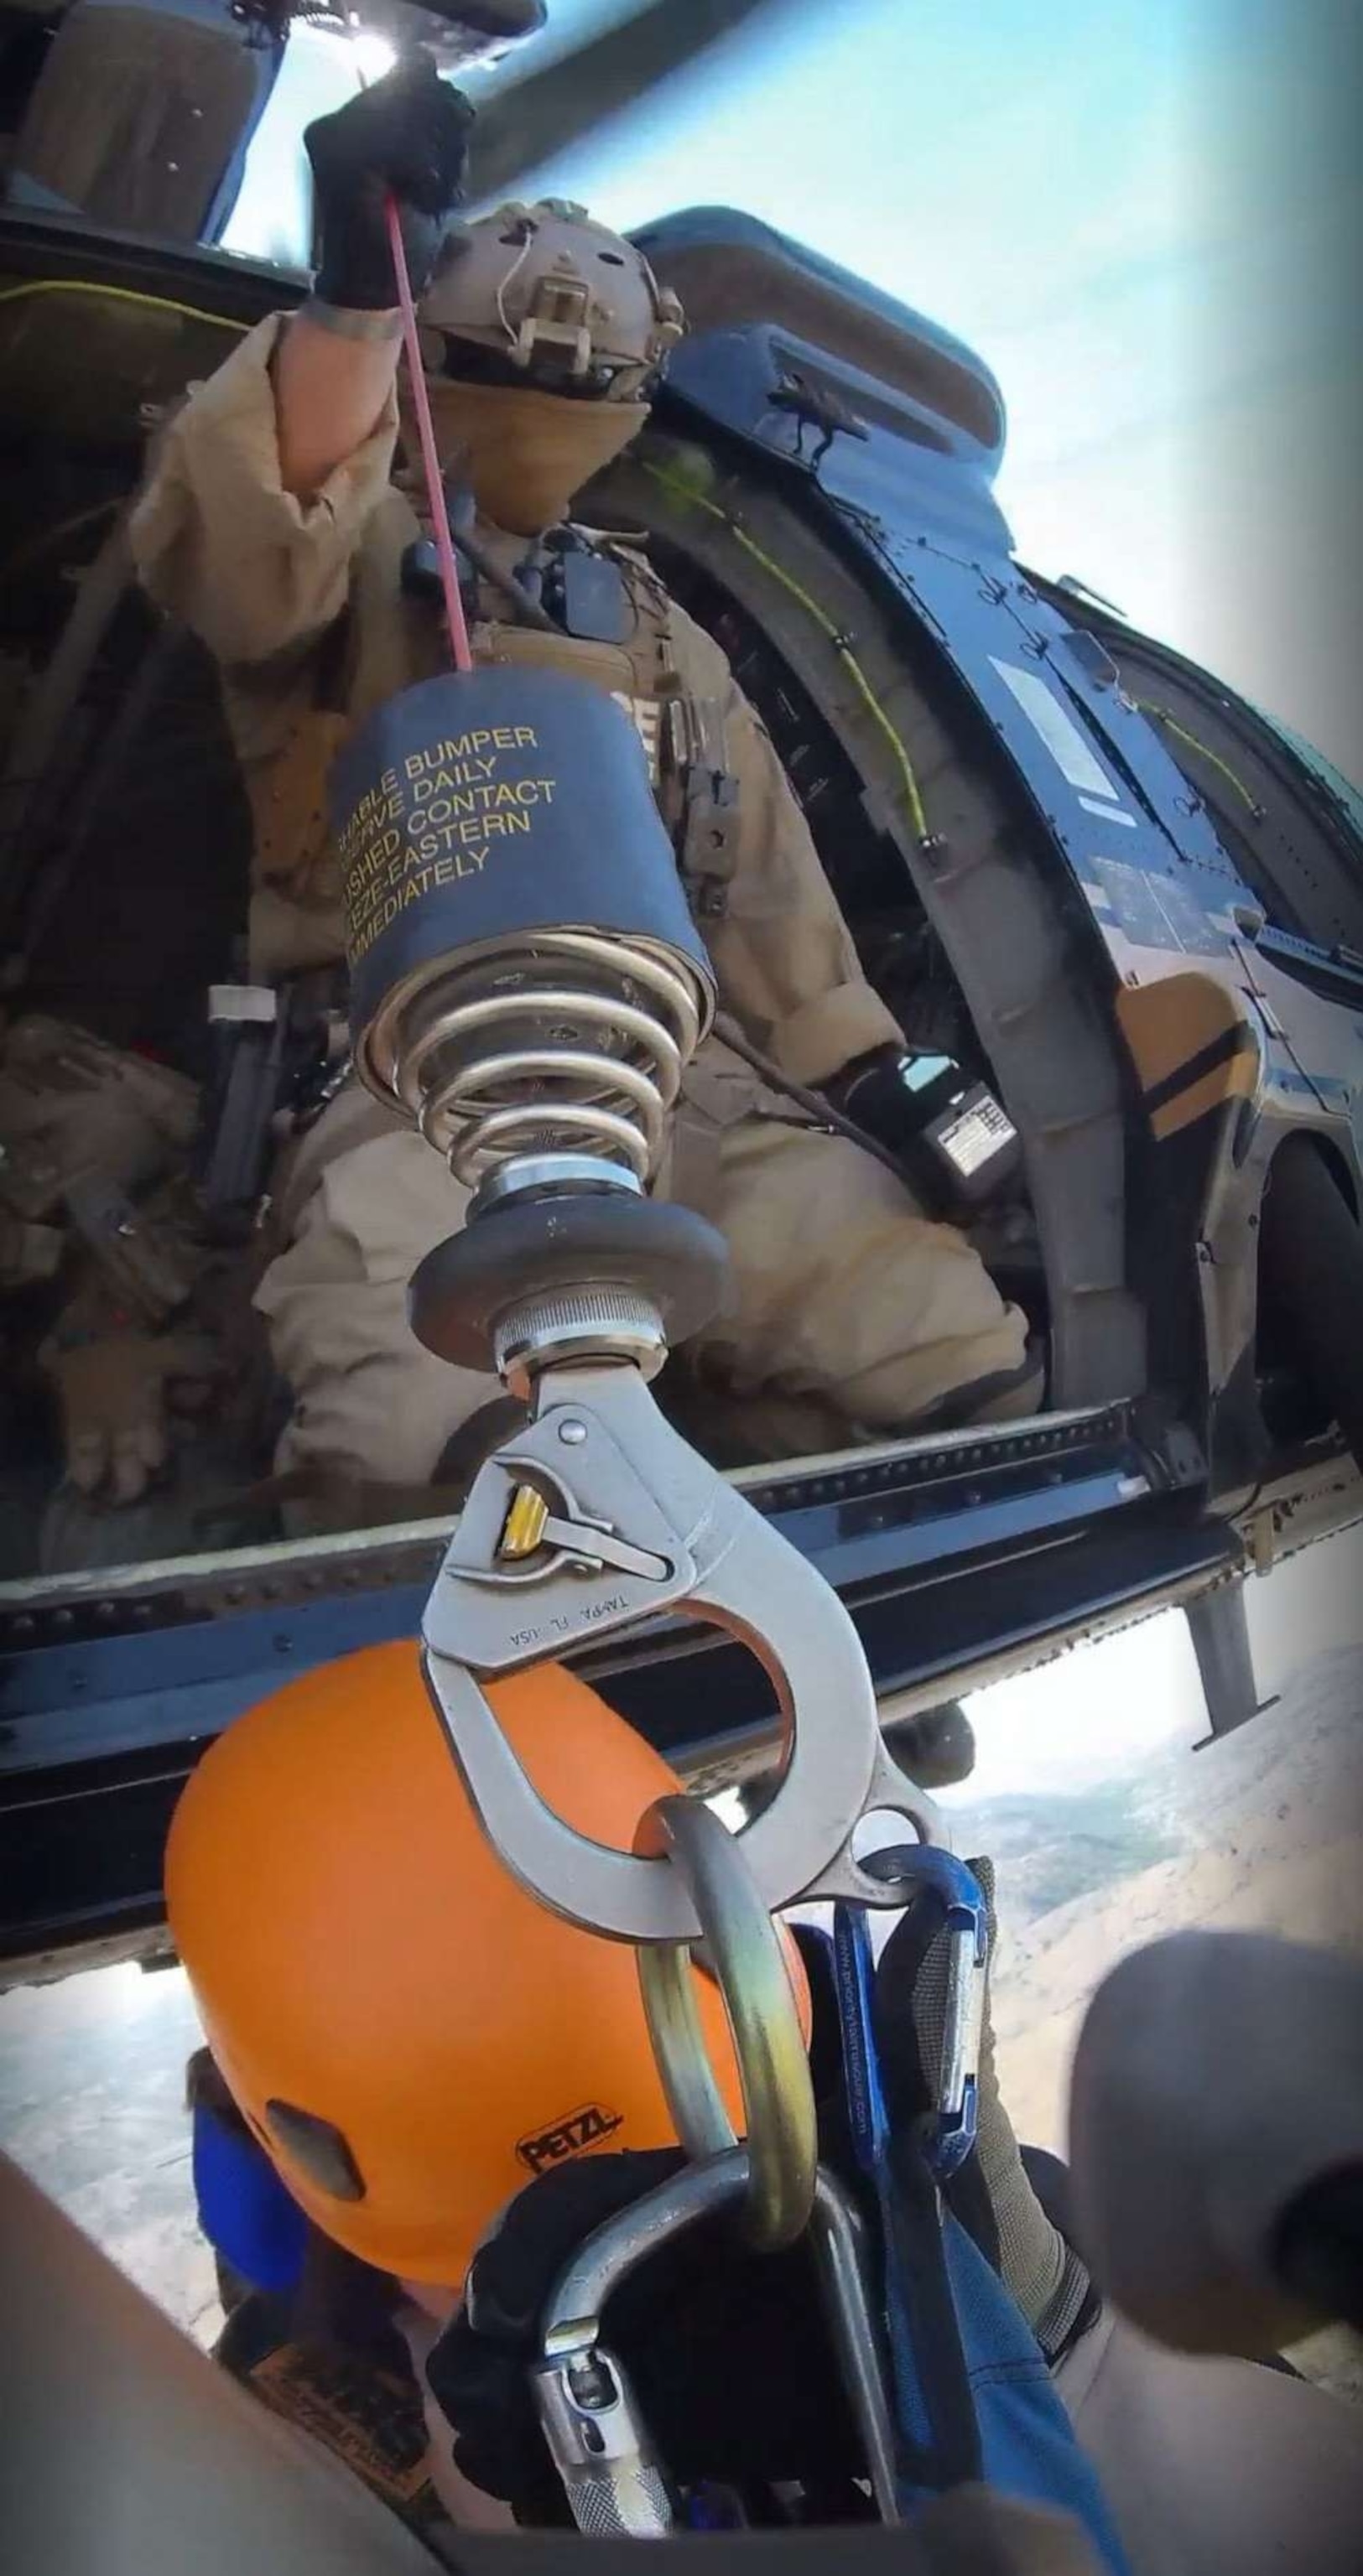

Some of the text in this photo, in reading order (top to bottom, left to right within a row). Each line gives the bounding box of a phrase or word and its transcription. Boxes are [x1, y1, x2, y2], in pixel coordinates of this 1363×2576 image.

[404, 726, 538, 780] BUMPER
[414, 756, 497, 802] DAILY
[407, 780, 556, 834] CONTACT
[519, 2107, 624, 2174] PETZL
